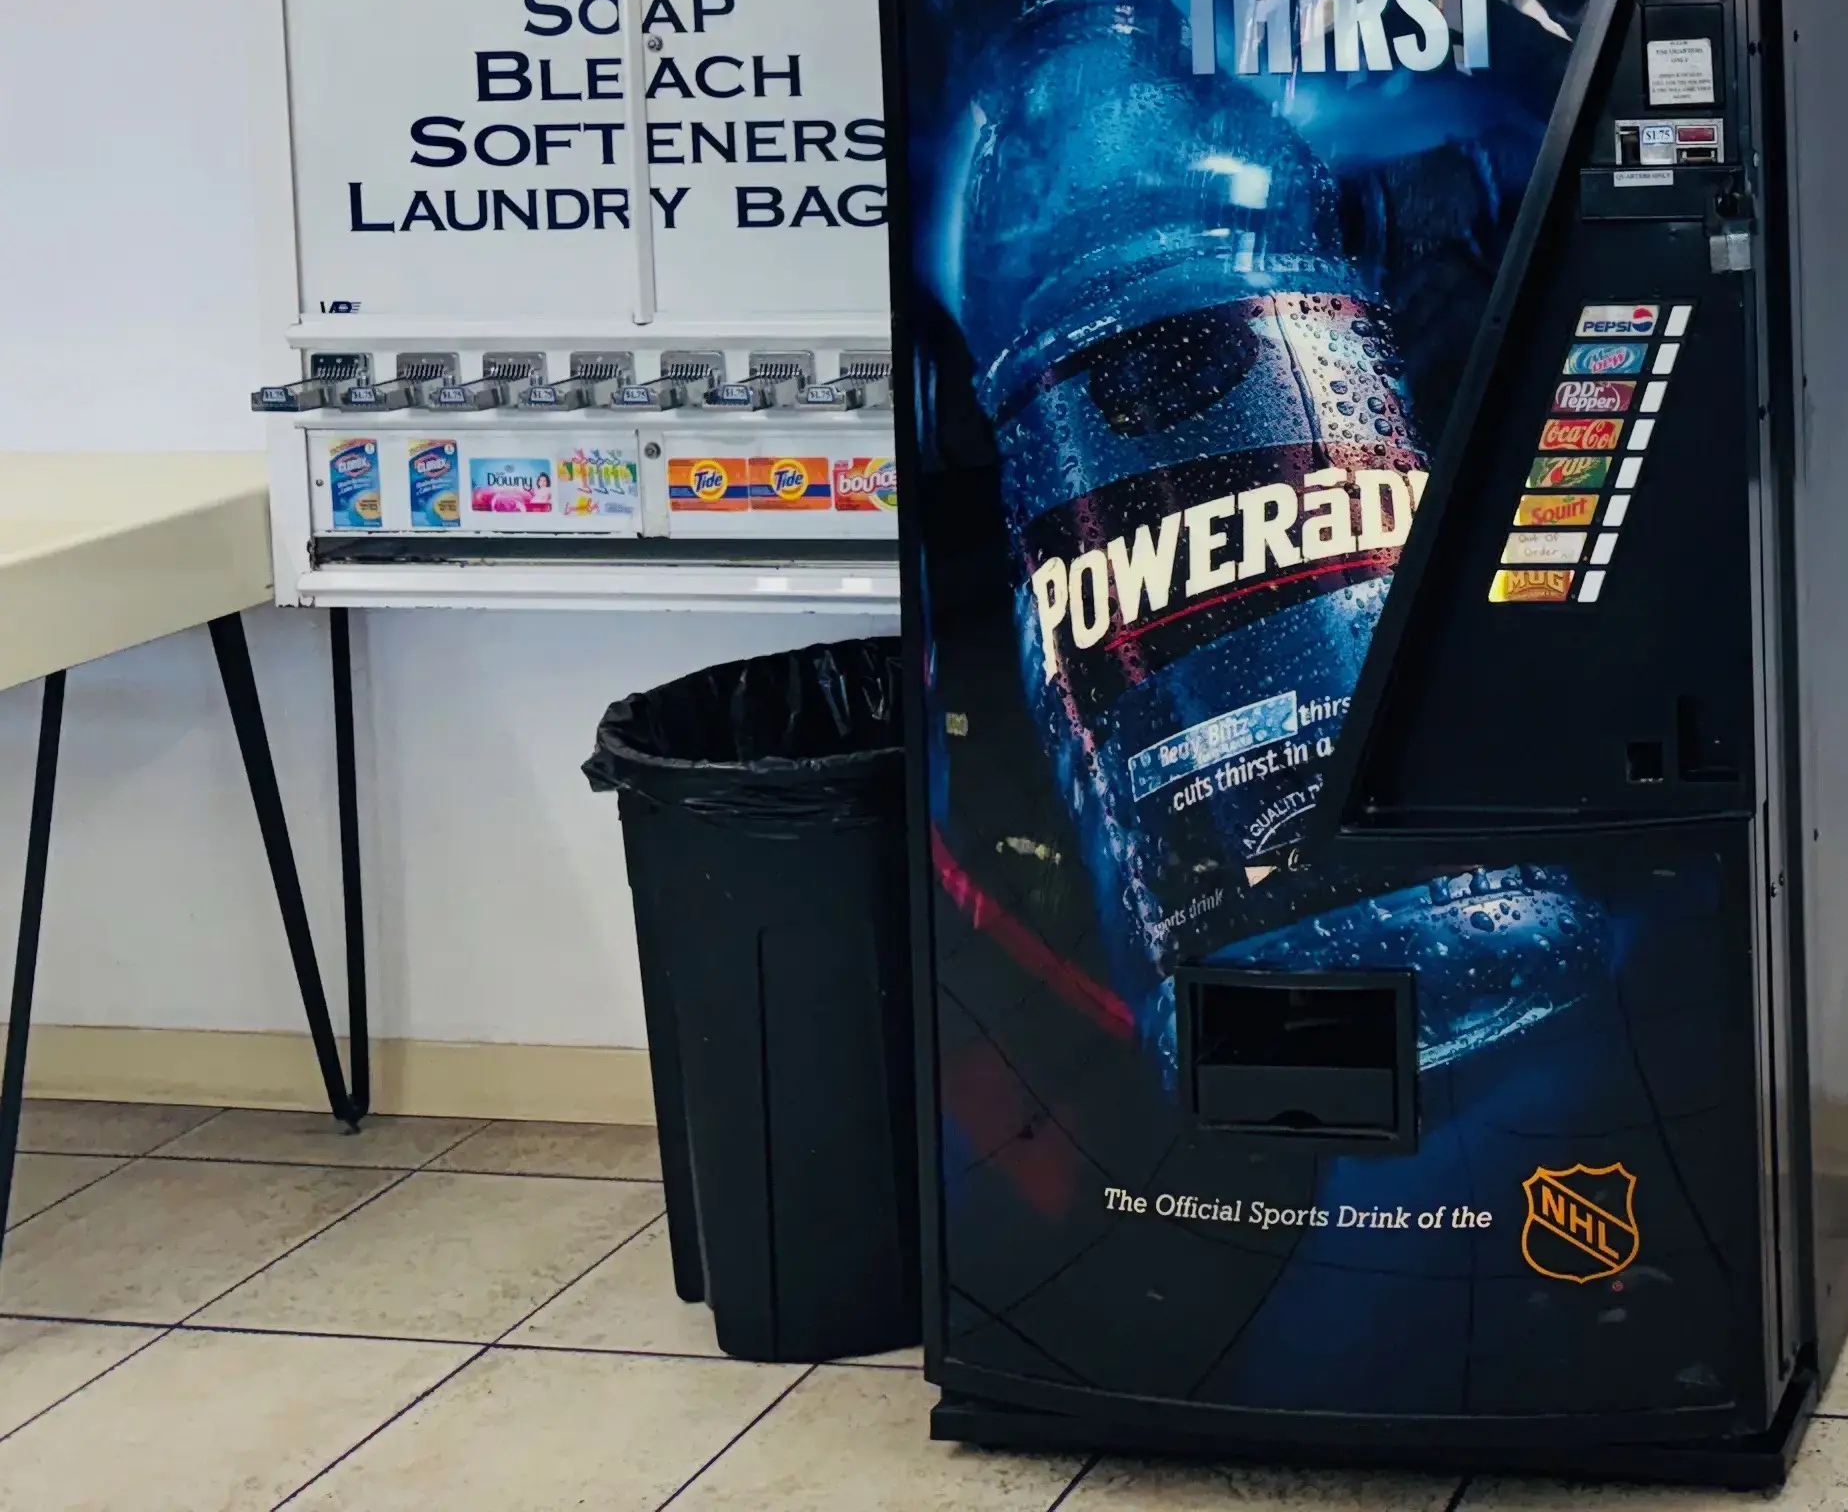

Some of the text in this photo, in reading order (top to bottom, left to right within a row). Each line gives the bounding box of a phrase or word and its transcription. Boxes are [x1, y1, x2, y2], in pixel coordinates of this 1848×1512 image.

[1645, 129, 1670, 141] $1.75
[1615, 172, 1651, 181] QUARTERS
[1583, 321, 1632, 333] PEPSI
[264, 391, 285, 400] $1.75
[352, 391, 373, 400] $1.75
[442, 391, 464, 400] $1.75
[532, 390, 553, 400] $1.75
[625, 389, 646, 399] $1.75
[725, 388, 746, 398] $1.75
[809, 389, 830, 399] $1.75
[1558, 381, 1616, 412] Pepper
[1582, 381, 1604, 398] Dr
[487, 472, 532, 491] Downy
[694, 470, 722, 491] Tide
[774, 469, 803, 491] Tide
[1531, 497, 1588, 524] Squirt
[1507, 570, 1564, 594] MUG
[1173, 775, 1214, 811] cuts
[1215, 748, 1279, 790] thirst
[1284, 739, 1309, 768] in
[1316, 736, 1334, 758] a
[1249, 789, 1306, 835] QUALITY
[1243, 837, 1257, 849] A
[1188, 888, 1224, 919] drink
[1104, 1187, 1493, 1231] The Official Sports Drink of the
[1540, 1183, 1619, 1261] NHL
